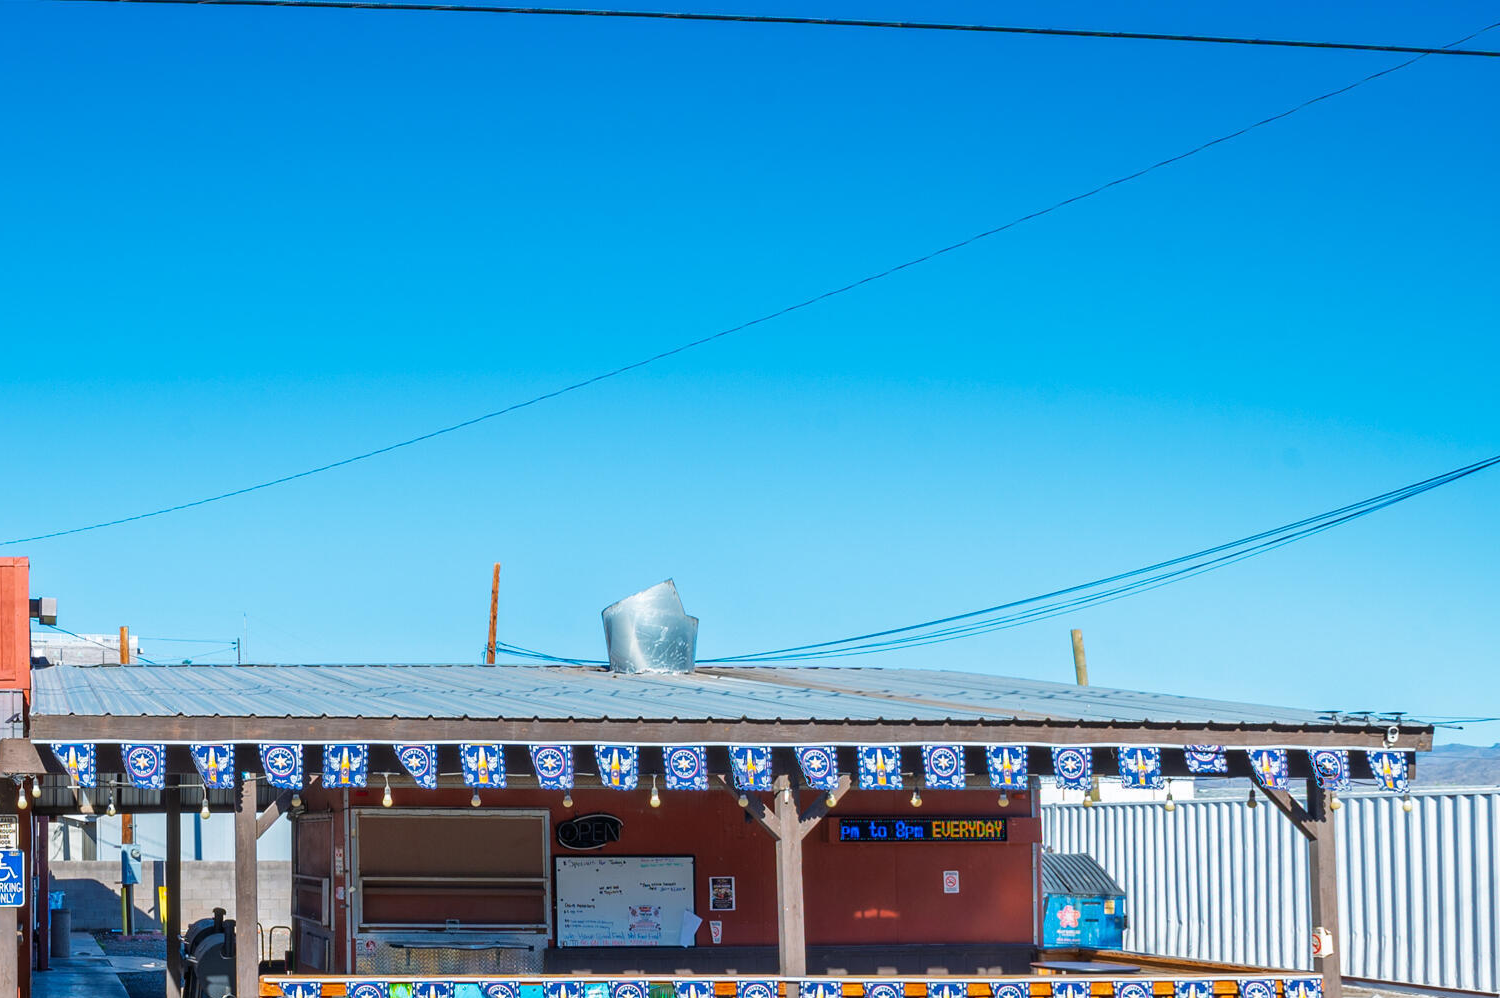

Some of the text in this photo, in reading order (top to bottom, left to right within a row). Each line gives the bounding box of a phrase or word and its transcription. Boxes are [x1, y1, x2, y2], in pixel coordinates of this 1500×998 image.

[558, 821, 621, 842] OPEN
[841, 820, 1003, 840] pm to 8pm EVERYDAY
